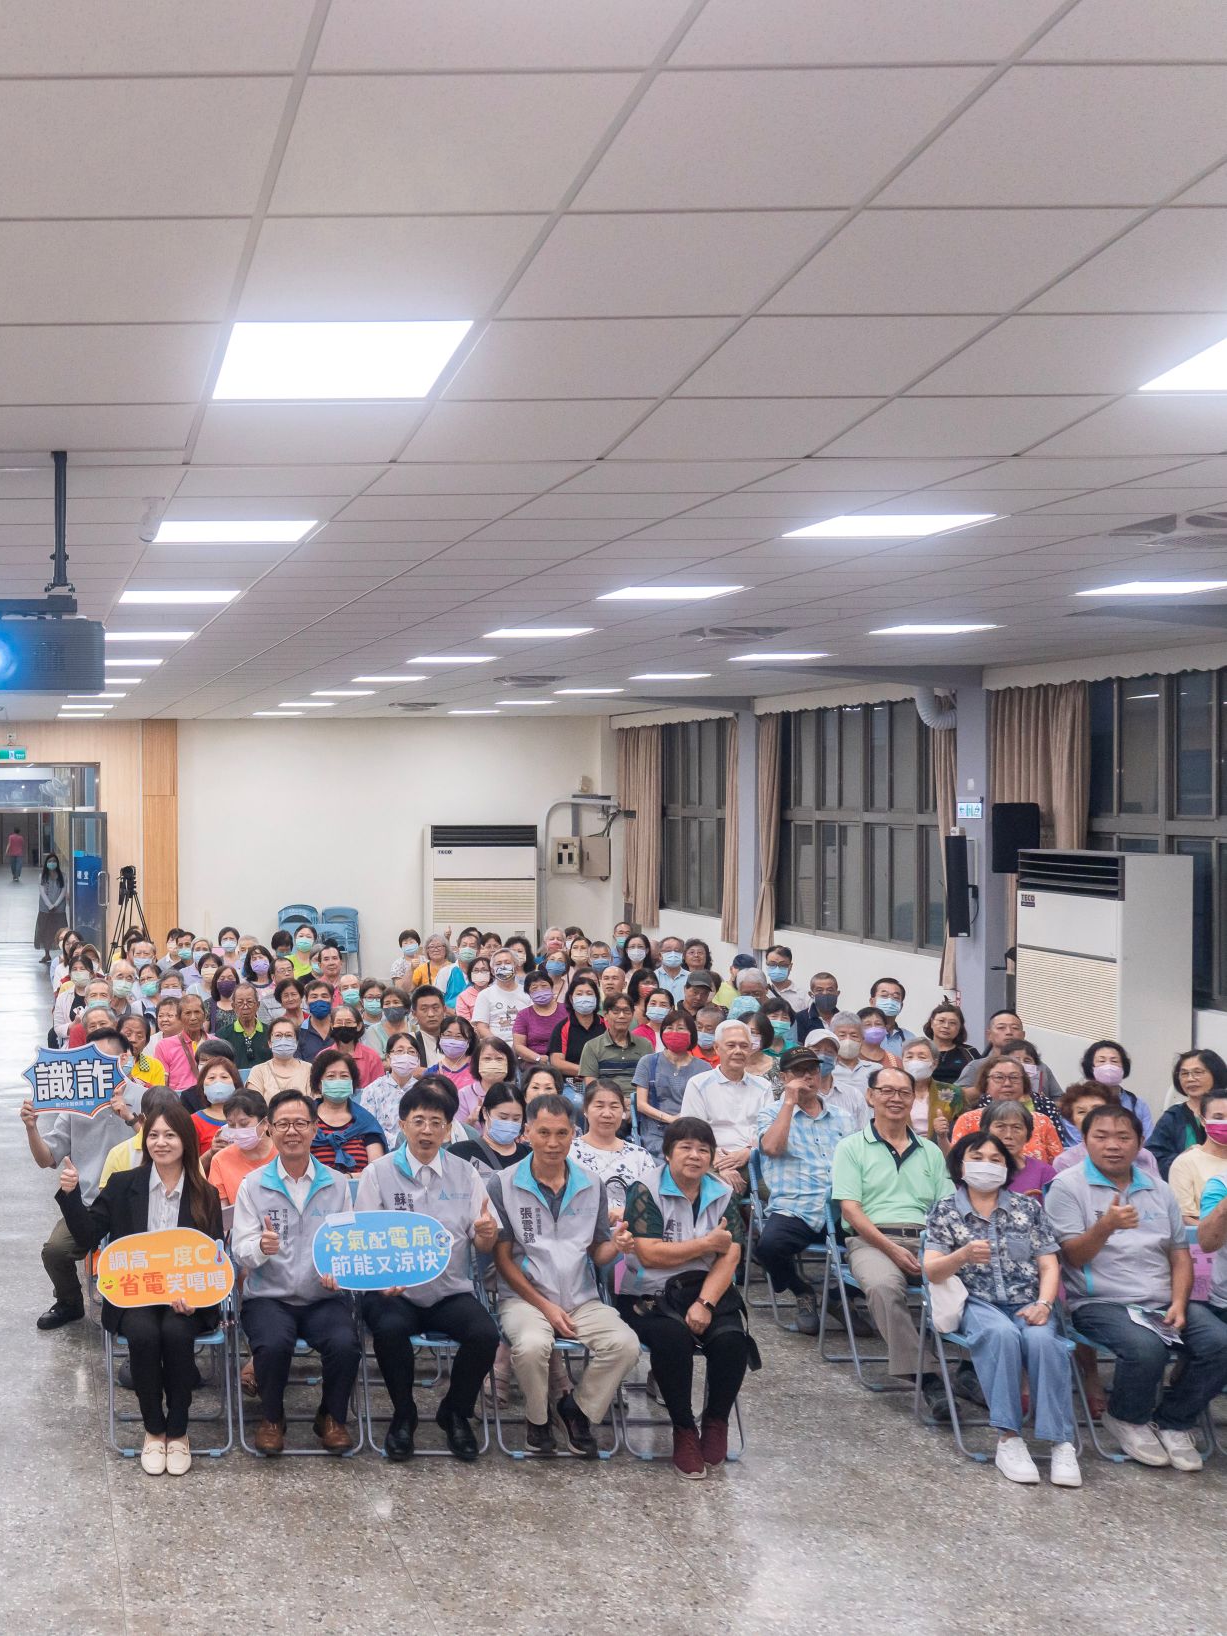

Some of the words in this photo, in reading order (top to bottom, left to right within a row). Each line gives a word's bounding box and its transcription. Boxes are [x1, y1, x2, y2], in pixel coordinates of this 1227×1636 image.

[1021, 894, 1035, 902] TECO
[35, 1060, 114, 1101] 識詐
[324, 1225, 434, 1253] 冷氣配電扇
[330, 1249, 440, 1277] 節能又涼快
[119, 1270, 227, 1296] 省電笑嘻嘻
